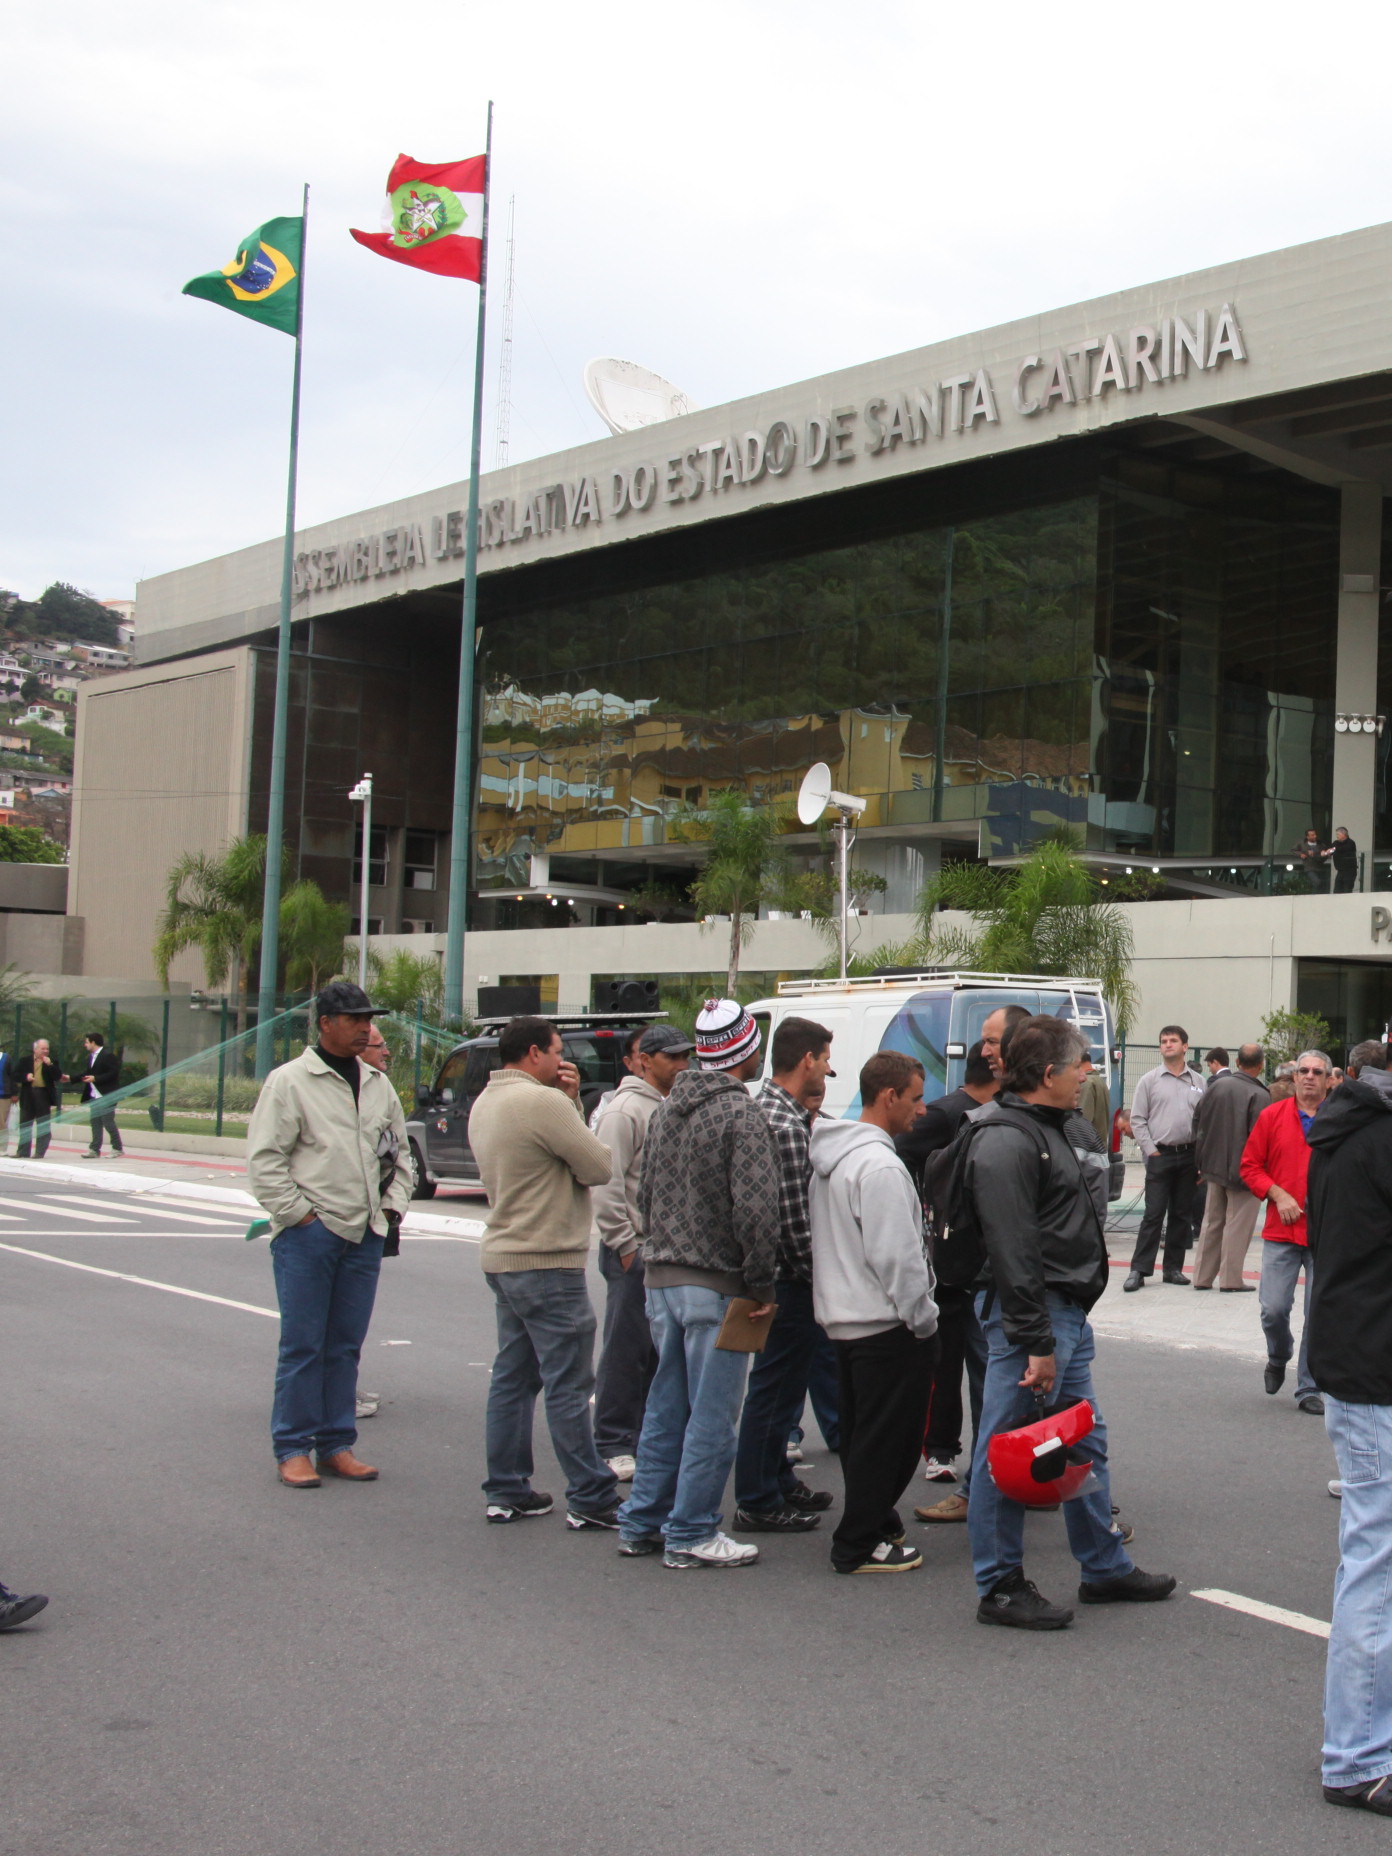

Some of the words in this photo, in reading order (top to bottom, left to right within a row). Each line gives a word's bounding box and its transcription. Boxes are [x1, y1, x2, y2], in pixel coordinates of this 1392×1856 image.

[292, 522, 426, 598] SSEMBLEIA
[609, 466, 657, 517] DO
[664, 420, 798, 504] ESTADO
[804, 404, 858, 469] DE
[863, 367, 1000, 455] SANTA
[1012, 302, 1247, 415] CATARINA
